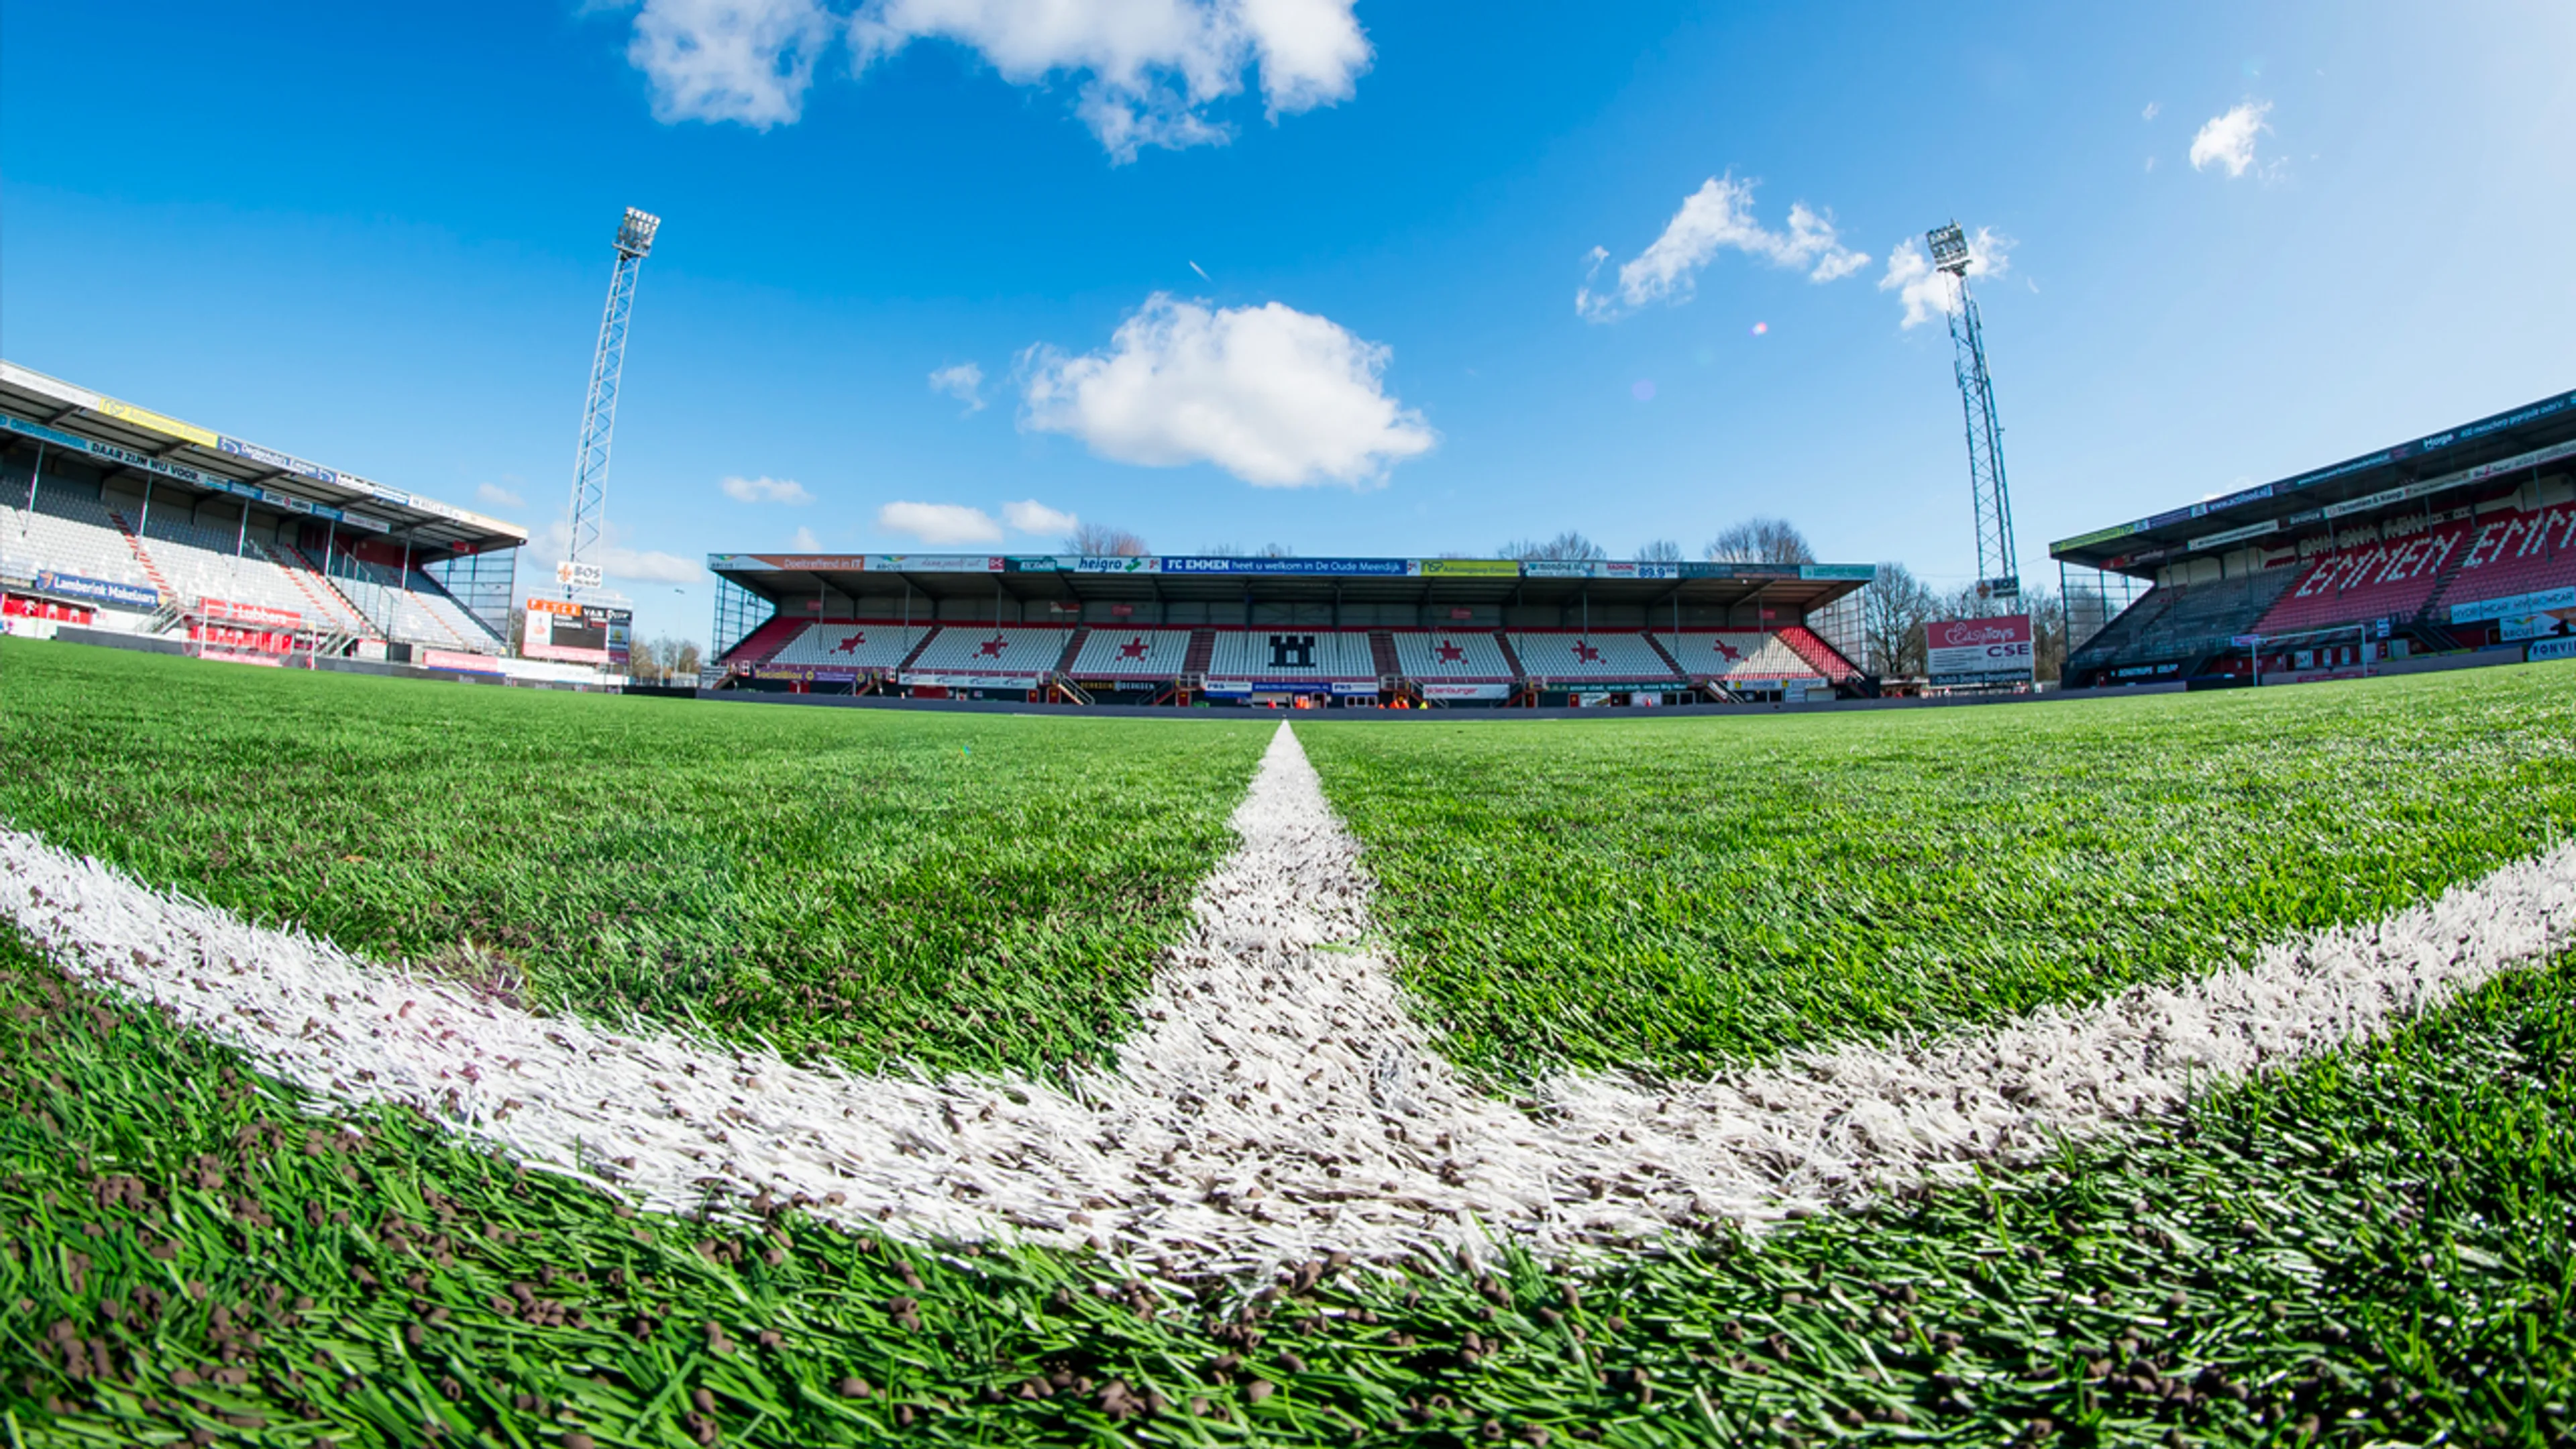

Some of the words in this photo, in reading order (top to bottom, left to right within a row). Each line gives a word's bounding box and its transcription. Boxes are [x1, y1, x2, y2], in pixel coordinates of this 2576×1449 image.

[91, 441, 123, 460] DAAR
[124, 452, 148, 466] ZIJN
[784, 557, 840, 569] Doeltreffend
[841, 559, 850, 568] in
[851, 558, 862, 568] IT
[1168, 559, 1183, 570] FC
[1185, 559, 1230, 570] EMMEN
[1232, 561, 1253, 570] heet
[1265, 561, 1303, 570] welkom
[1304, 561, 1313, 570] in
[1316, 562, 1328, 570] De
[1330, 562, 1356, 570] Oude
[1359, 562, 1400, 573] Meerdijk
[574, 566, 601, 578] BOS
[54, 575, 107, 596] Lamberink
[108, 585, 156, 604] Makelaars
[238, 606, 287, 625] Lubbers
[531, 600, 578, 616] PETER
[1986, 644, 2029, 657] CSE
